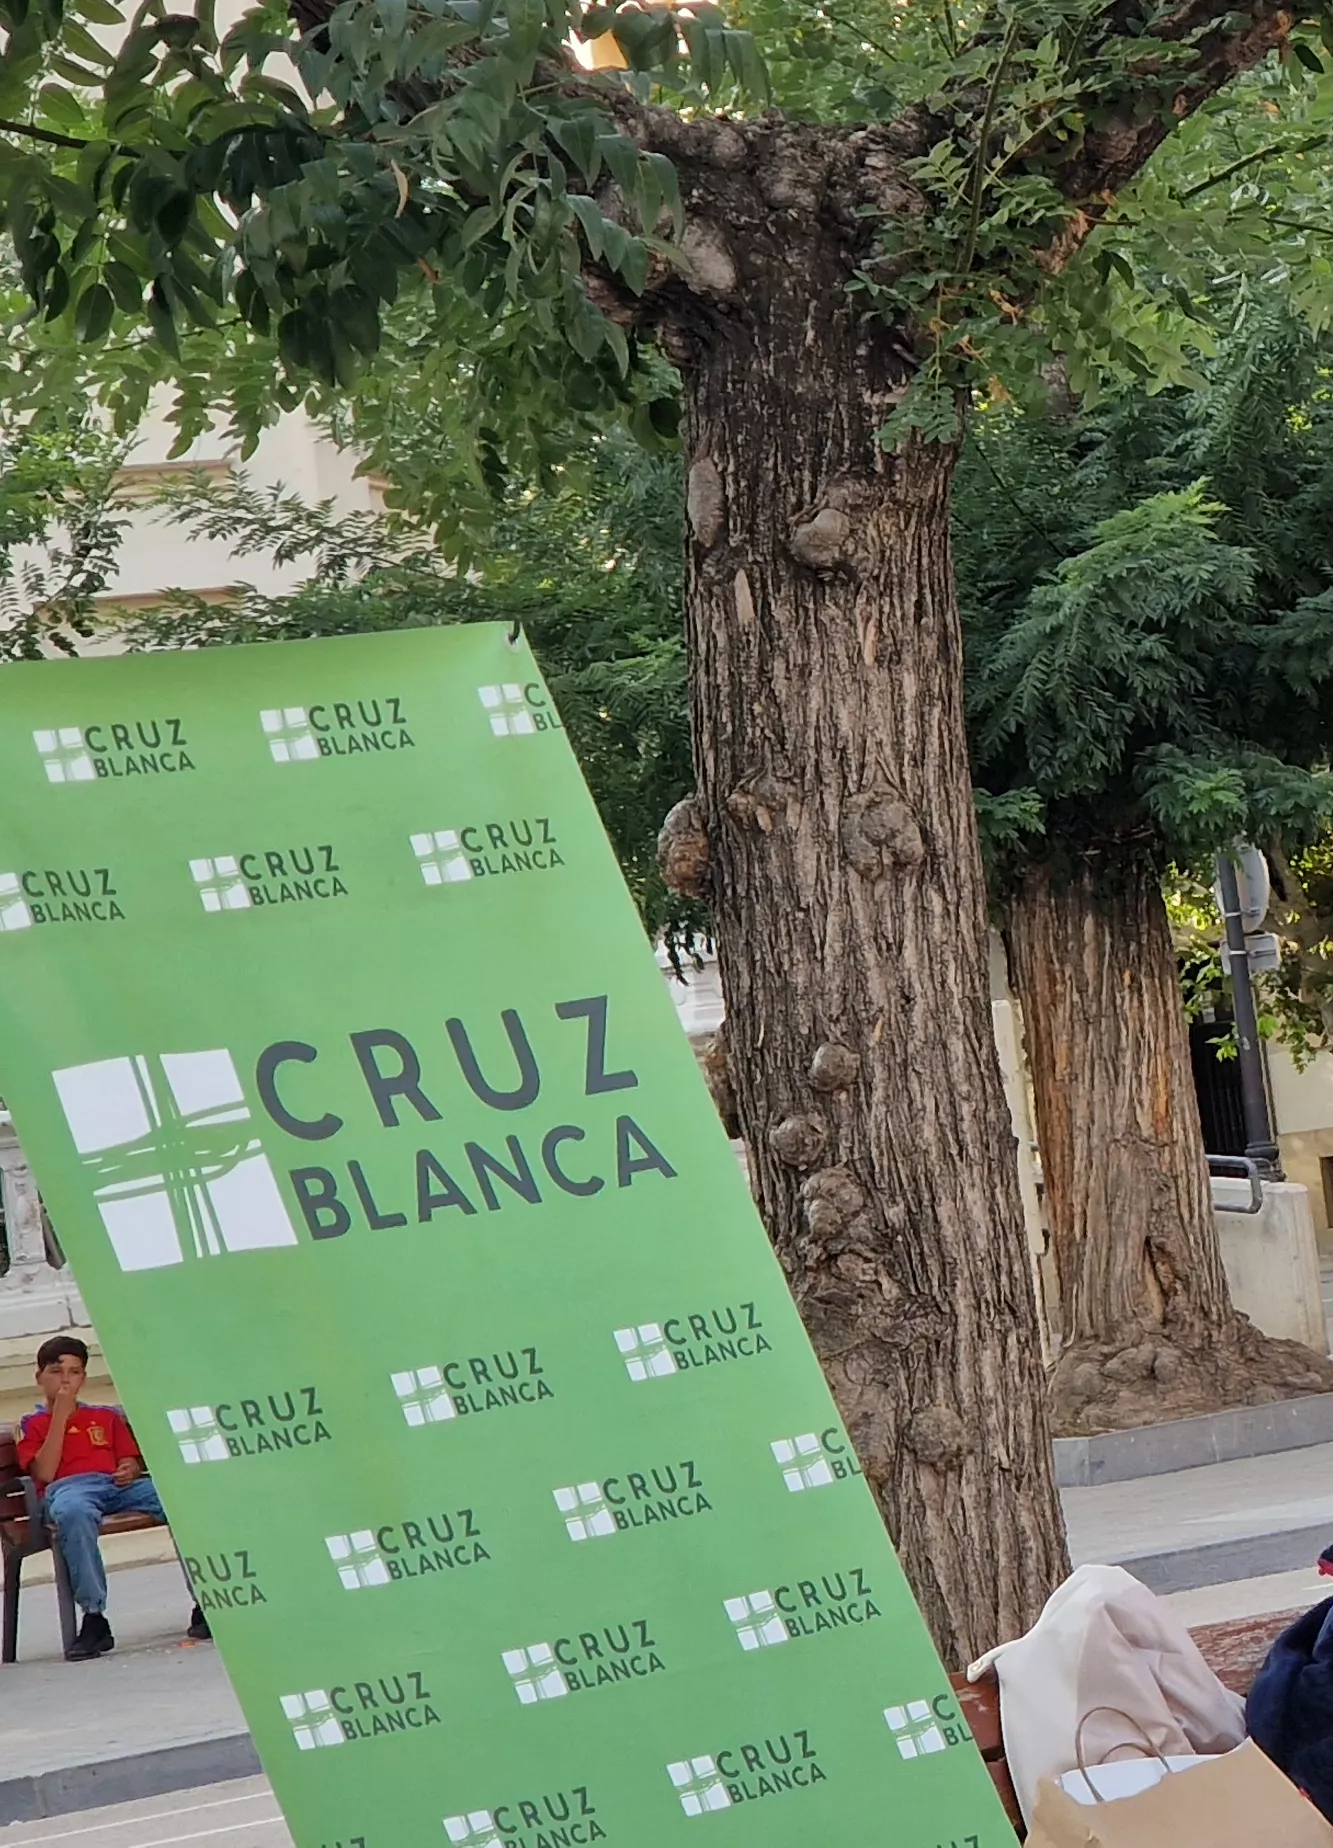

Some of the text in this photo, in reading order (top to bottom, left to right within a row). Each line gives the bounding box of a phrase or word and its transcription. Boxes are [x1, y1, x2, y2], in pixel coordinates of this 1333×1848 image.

[309, 698, 406, 732] CRUZ
[85, 719, 187, 753] CRUZ
[317, 729, 415, 756] BLANCA
[93, 751, 196, 778] BLANCA
[461, 818, 556, 852] CRUZ
[240, 845, 339, 880] CRUZ
[469, 848, 565, 877] BLANCA
[22, 869, 117, 897] CRUZ
[248, 876, 348, 905] BLANCA
[30, 900, 125, 924] BLANCA
[256, 994, 638, 1141] CRUZ
[288, 1114, 678, 1241] BLANCA
[664, 1302, 763, 1345] CRUZ
[443, 1347, 543, 1389] CRUZ
[673, 1334, 772, 1370] BLANCA
[216, 1387, 323, 1431] CRUZ
[452, 1380, 554, 1415] BLANCA
[226, 1421, 332, 1457] BLANCA
[603, 1461, 702, 1504] CRUZ
[612, 1492, 712, 1530] BLANCA
[377, 1509, 480, 1554] CRUZ
[386, 1542, 491, 1580] BLANCA
[775, 1568, 871, 1612] CRUZ
[785, 1600, 881, 1637] BLANCA
[554, 1620, 655, 1665] CRUZ
[564, 1652, 665, 1691] BLANCA
[330, 1672, 431, 1714] CRUZ
[341, 1704, 441, 1740] BLANCA
[717, 1730, 816, 1778] CRUZ
[726, 1763, 827, 1804] BLANCA
[494, 1786, 595, 1833] CRUZ
